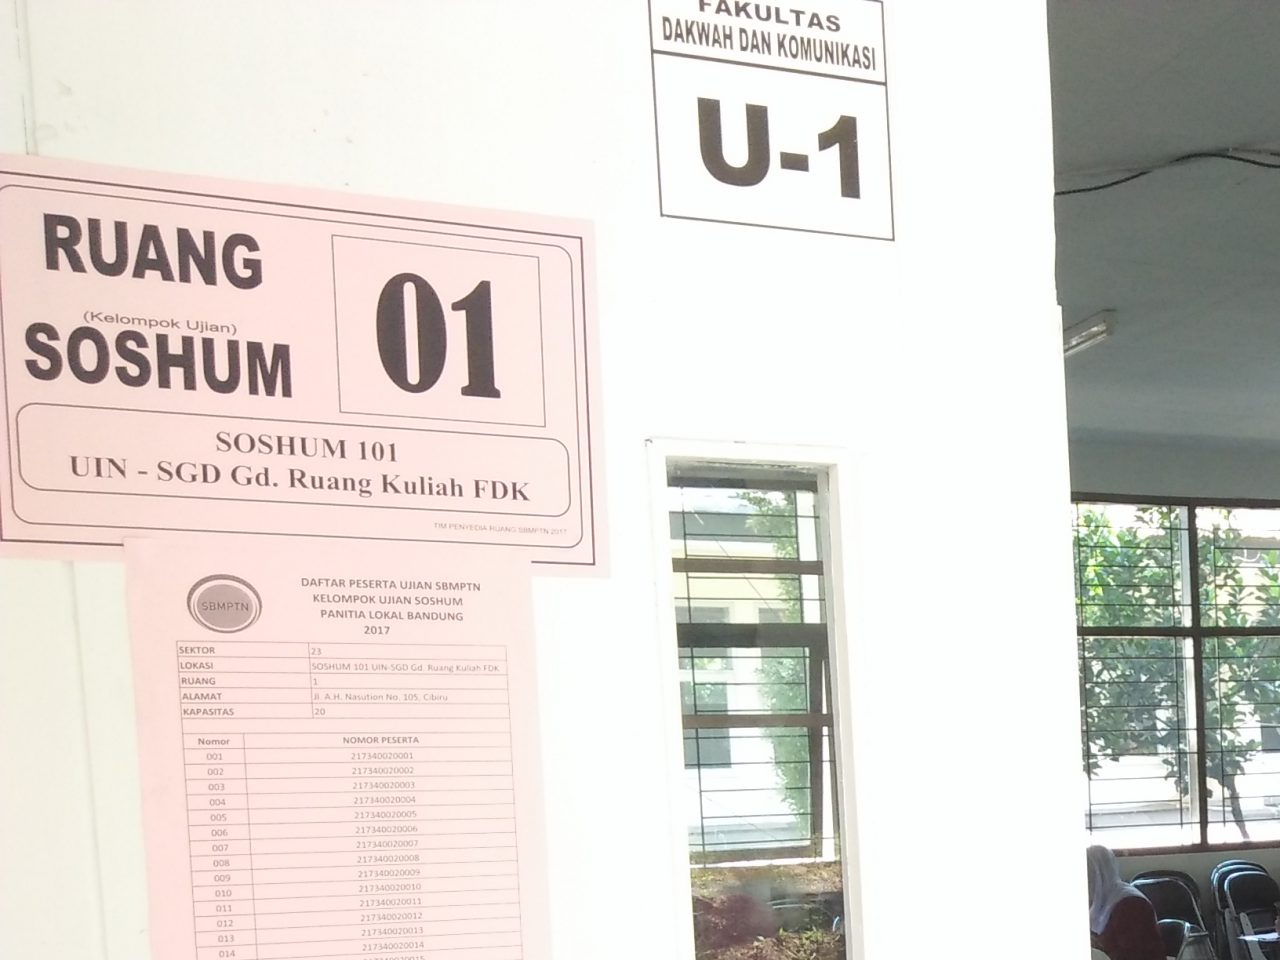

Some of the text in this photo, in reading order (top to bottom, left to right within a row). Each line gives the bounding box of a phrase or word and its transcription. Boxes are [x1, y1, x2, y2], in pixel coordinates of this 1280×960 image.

[699, 0, 841, 32] FAKULTAS
[662, 15, 876, 71] DAKWAH DAN KOMUNIKASI
[697, 97, 860, 199] U-1
[43, 213, 263, 289] RUANG
[83, 311, 237, 336] (Kelompok Ujian)
[376, 272, 501, 399] 01
[23, 322, 293, 398] SOSHUM
[215, 431, 398, 463] SOSHUM 101
[70, 455, 127, 480] UIN
[157, 461, 221, 485] SGD
[231, 466, 279, 489] Gd.
[288, 468, 372, 498] Ruang
[381, 474, 463, 498] Kuliah
[473, 479, 530, 502] FDK
[301, 578, 481, 591] DAFTAR PESERTA UJIAN SBMPTN
[313, 594, 463, 606] KELOMPOK UJIAN SOSHUM
[201, 601, 249, 612] SBMPTN
[321, 609, 464, 621] PANITIA LOKAL BANDUNG
[364, 626, 390, 635] 2017
[179, 646, 216, 655] SEKTOR
[311, 648, 322, 656] 23
[180, 661, 214, 670] LOKASI
[312, 663, 350, 671] SOSHUM
[354, 663, 368, 671] 101
[428, 664, 453, 673] Ruang
[456, 664, 481, 672] Kuliah
[181, 677, 216, 686] RUANG
[182, 692, 222, 701] ALAMAT
[345, 693, 383, 701] Nasution
[182, 708, 234, 716] KAPASITAS
[314, 708, 326, 716] 20
[198, 738, 230, 746] Nomor
[342, 736, 419, 744] NOMOR PESERTA
[206, 752, 223, 761] 001
[207, 767, 224, 776] 002
[208, 782, 225, 791] 003
[209, 797, 226, 806] 004
[210, 812, 227, 821] 005
[211, 828, 228, 837] 006
[212, 843, 229, 852] 007
[213, 858, 230, 867] 008
[214, 873, 231, 882] 009
[215, 888, 232, 897] 010
[216, 903, 233, 912] 011
[216, 918, 233, 927] 012
[217, 933, 234, 942] 013
[218, 948, 235, 957] 014
